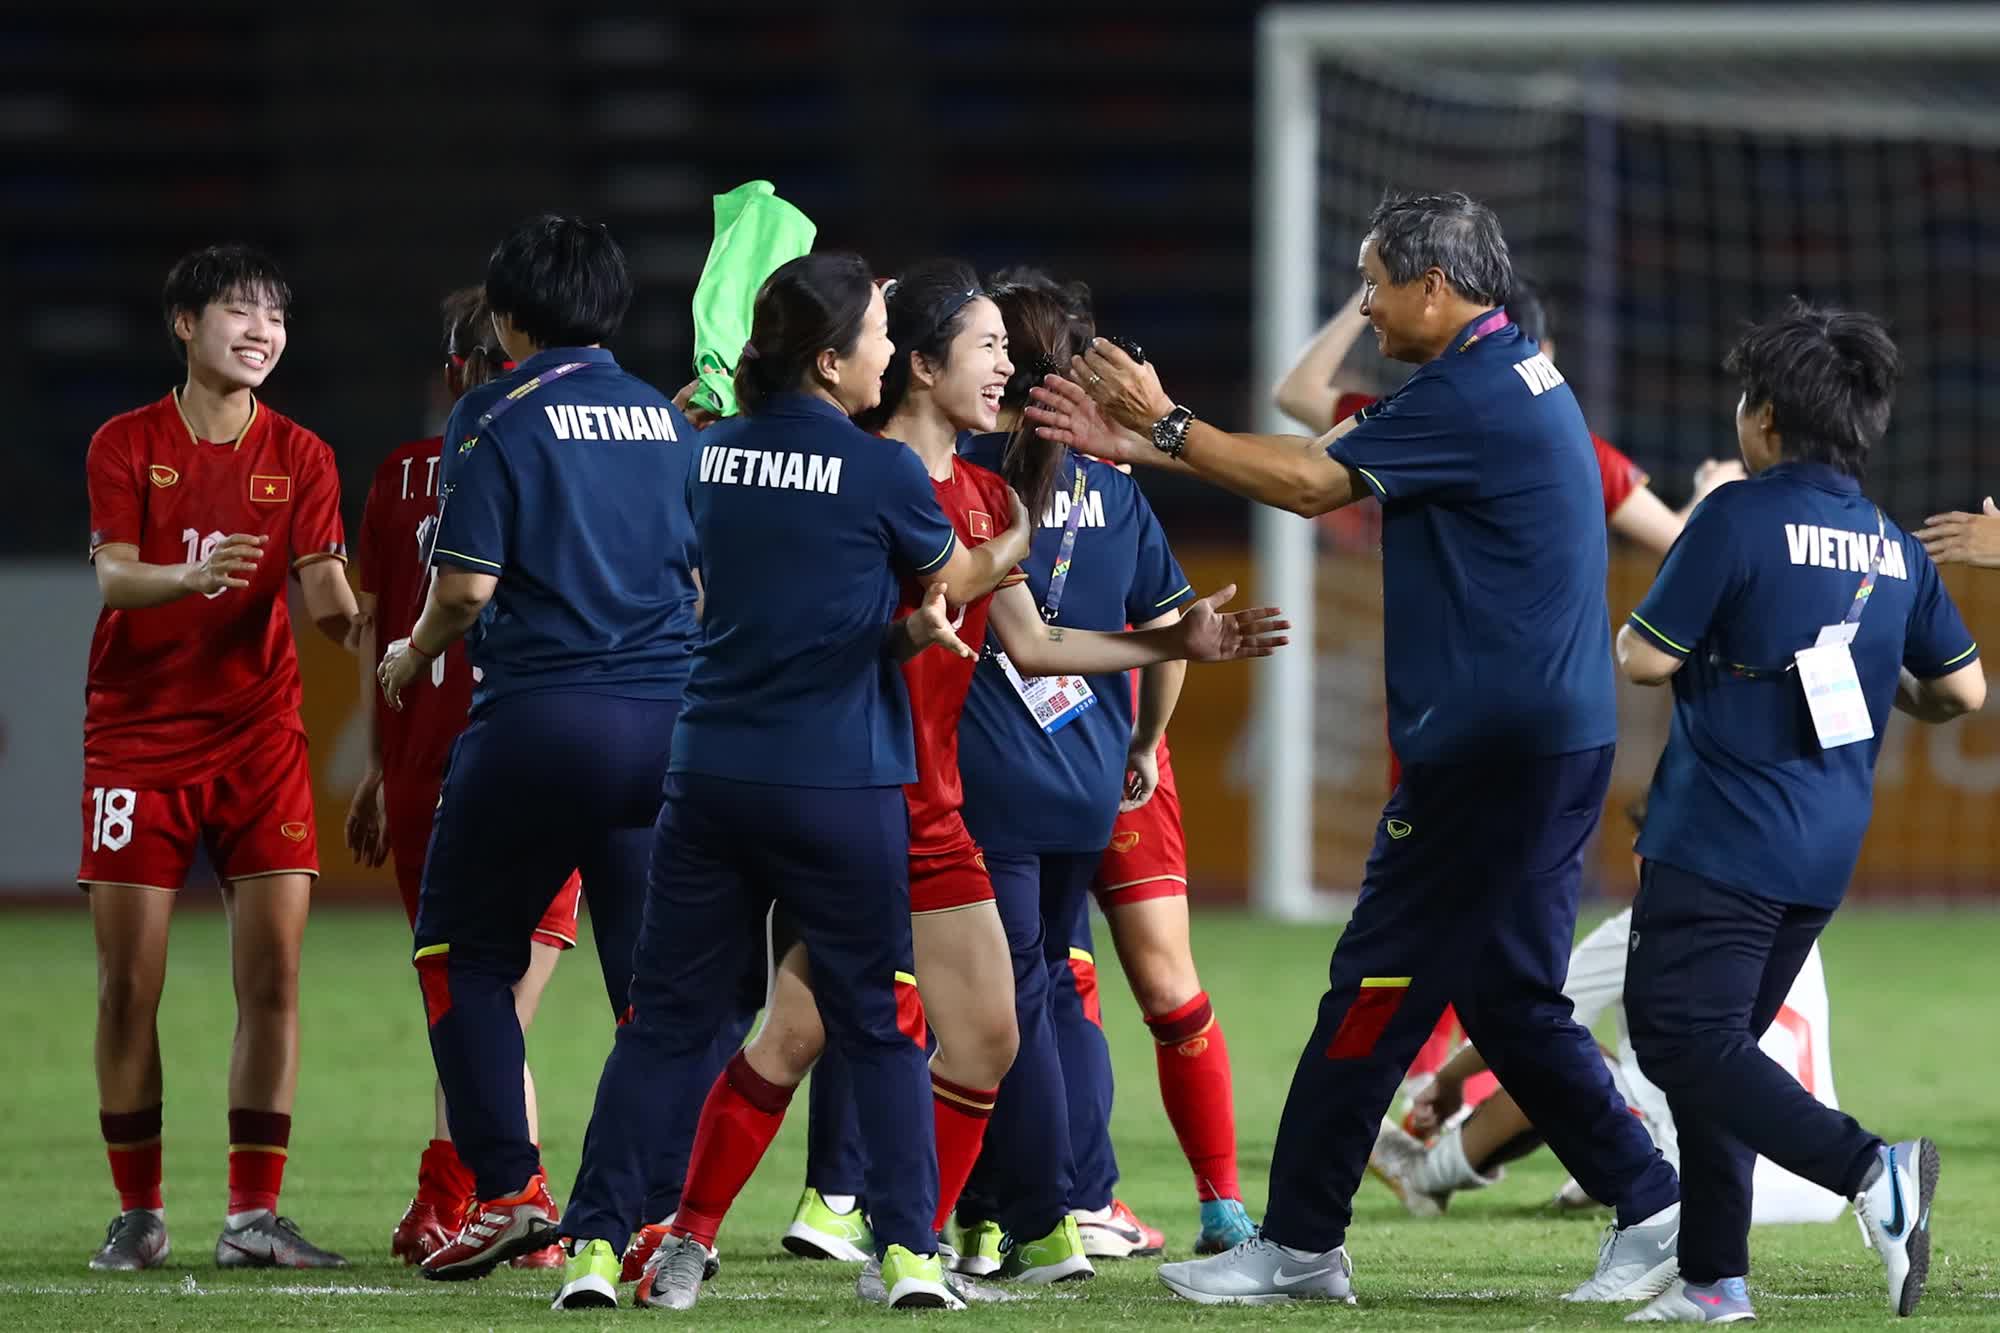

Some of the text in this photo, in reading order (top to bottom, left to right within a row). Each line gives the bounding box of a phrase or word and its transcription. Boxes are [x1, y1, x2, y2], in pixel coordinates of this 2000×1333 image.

[544, 404, 679, 442] VIETNAM
[426, 455, 441, 497] T
[699, 445, 843, 495] VIETNAM
[92, 787, 137, 852] 18
